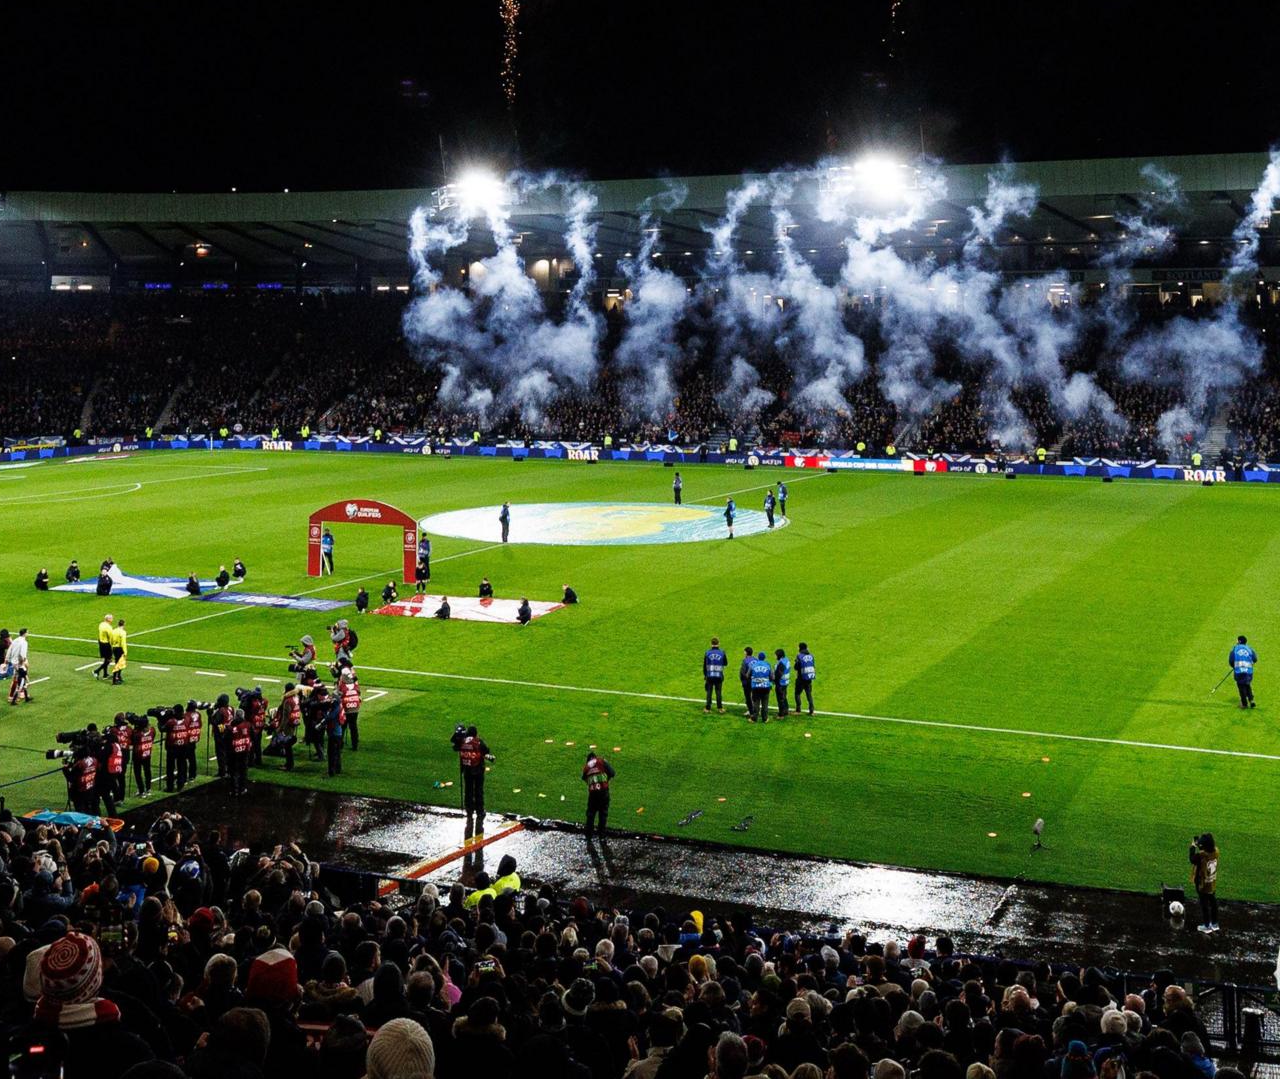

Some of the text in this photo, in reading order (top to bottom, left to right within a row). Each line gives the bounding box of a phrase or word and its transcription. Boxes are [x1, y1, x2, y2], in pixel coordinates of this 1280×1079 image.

[262, 441, 292, 450] ROAR
[568, 450, 599, 460] ROAR
[1183, 469, 1226, 482] ROAR
